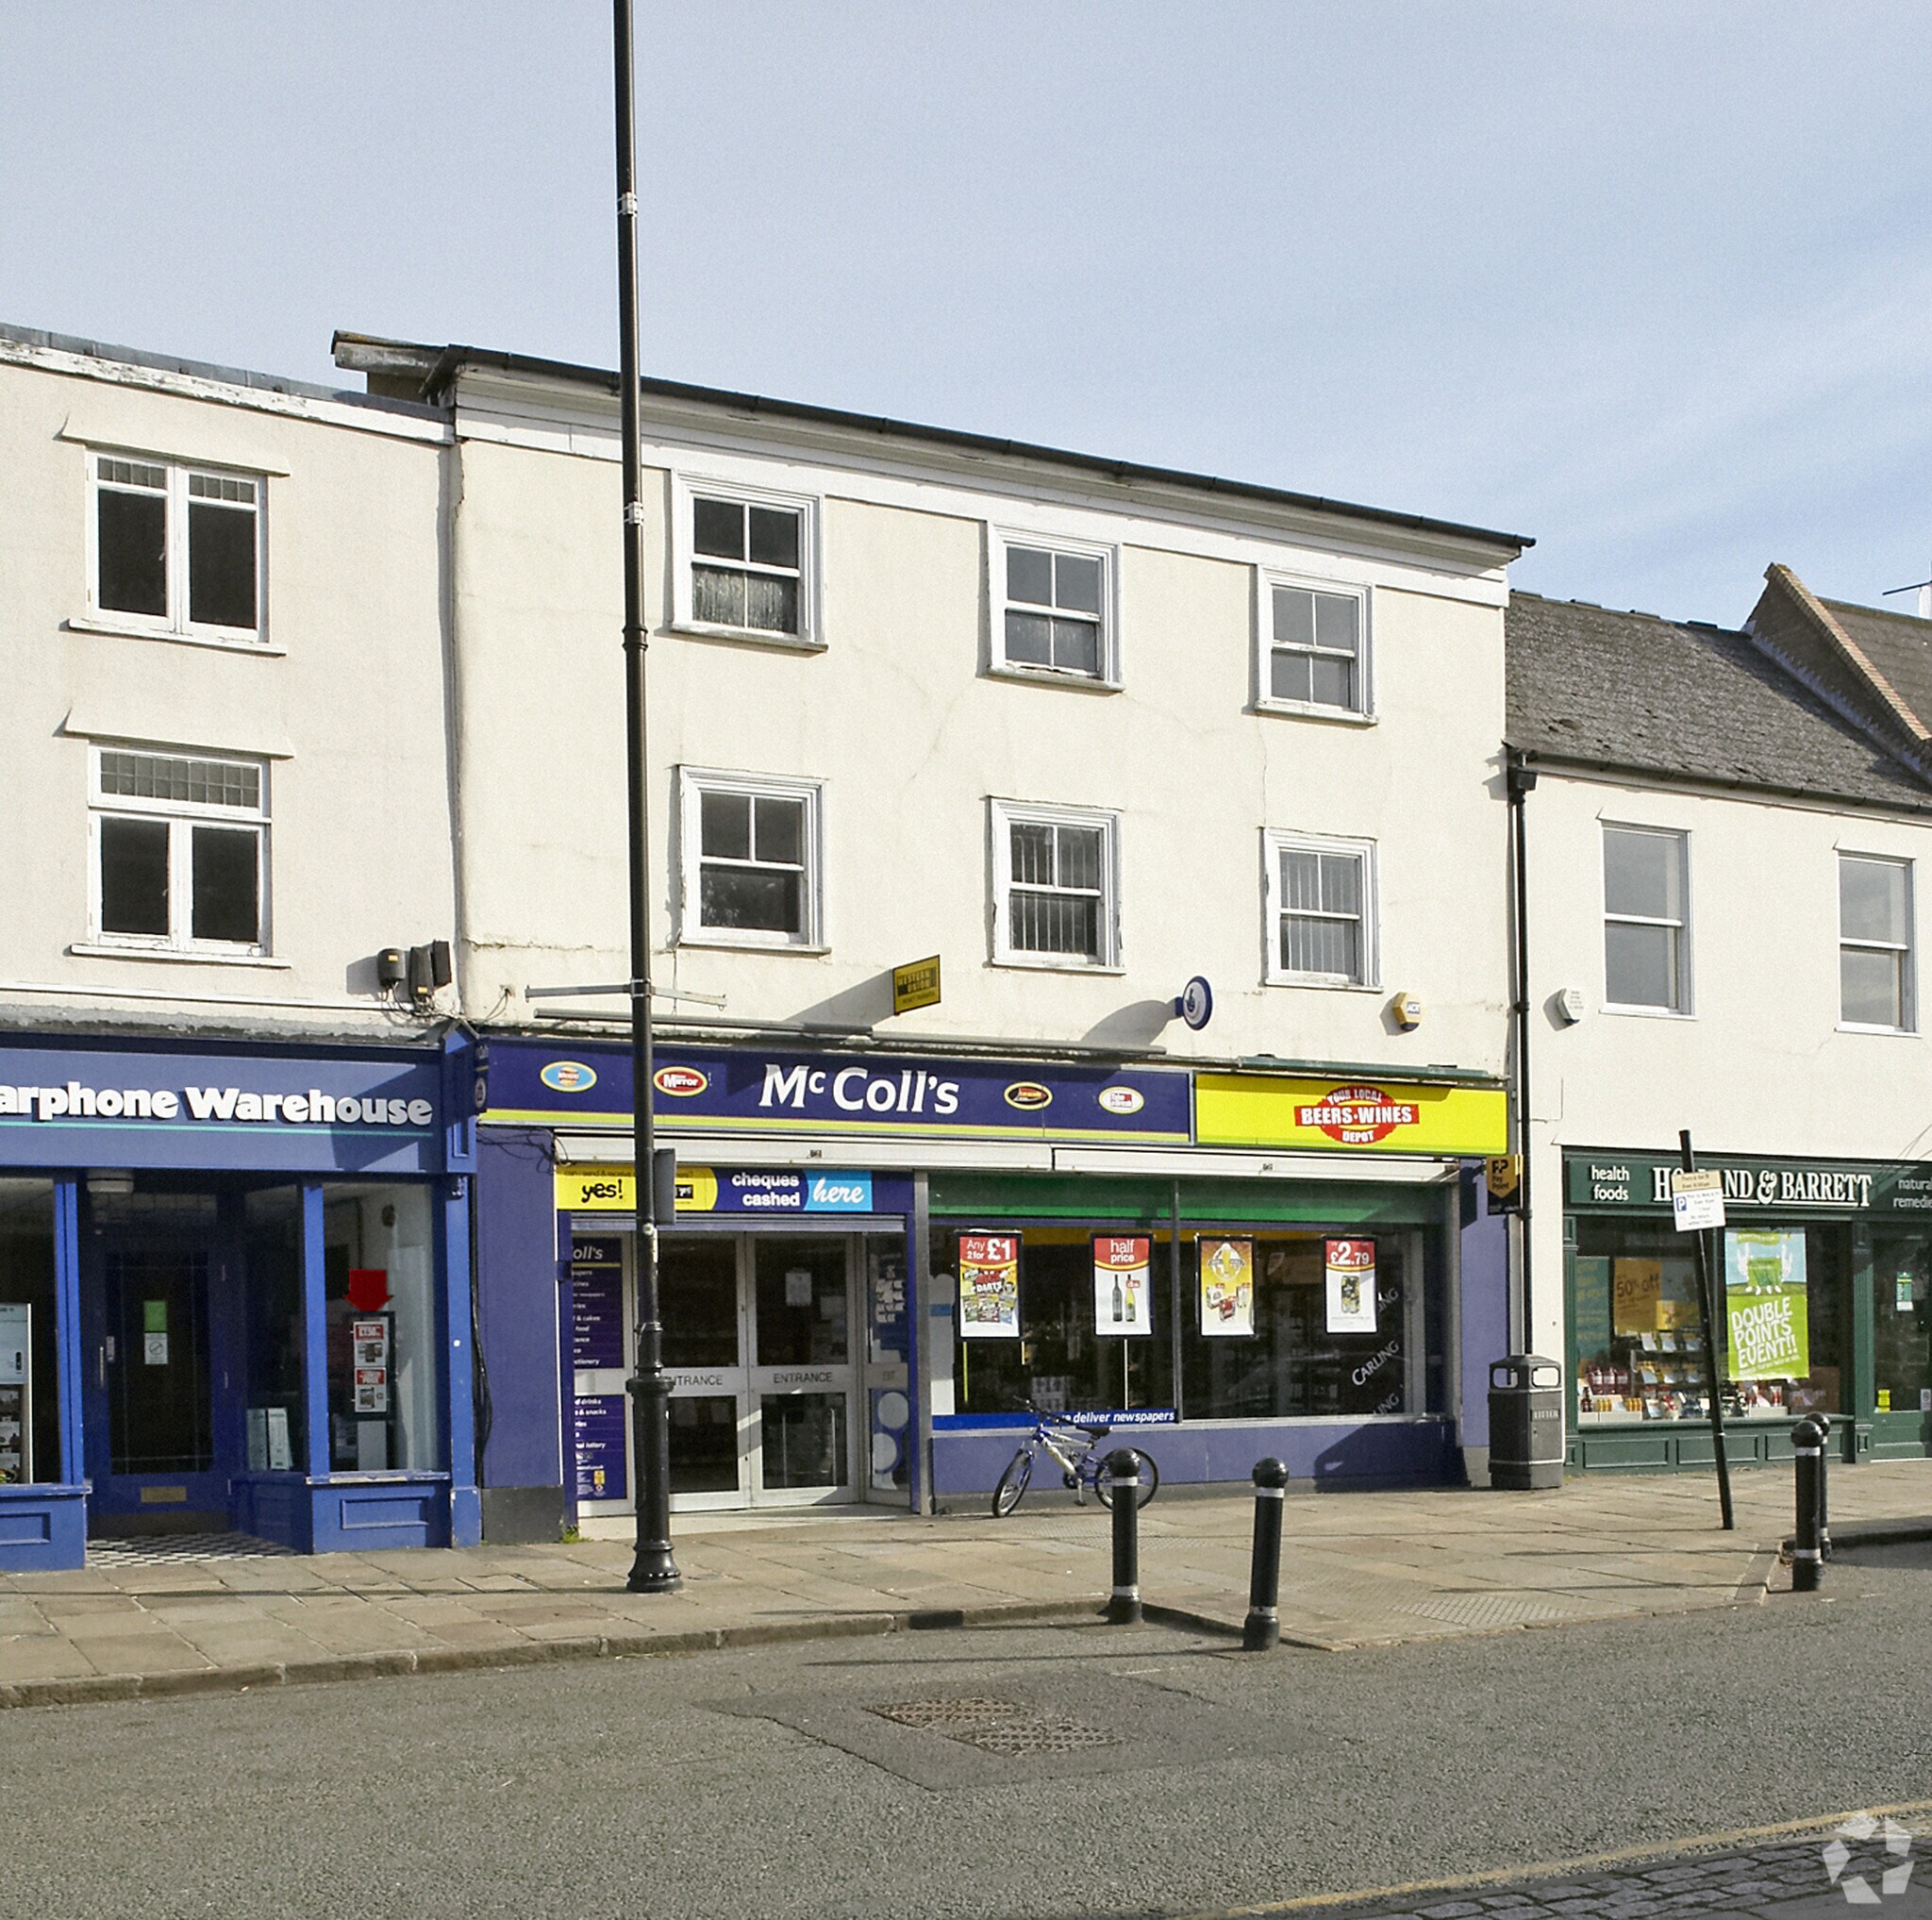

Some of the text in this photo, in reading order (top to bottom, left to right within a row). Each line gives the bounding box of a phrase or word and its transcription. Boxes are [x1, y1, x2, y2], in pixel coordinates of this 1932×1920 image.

[185, 1087, 433, 1126] Warehouse
[1326, 1089, 1382, 1105] YOUR LOCAL
[1341, 1130, 1374, 1143] DEPOT
[731, 1173, 799, 1190] cheques
[1591, 1165, 1630, 1181] health
[581, 1179, 623, 1203] yes!
[742, 1177, 864, 1207] cashed here
[1593, 1184, 1629, 1201] foods
[1757, 1170, 1777, 1205] &
[1780, 1172, 1873, 1207] BARRETT
[573, 1245, 604, 1260] oll's
[967, 1238, 1011, 1261] Any £1
[1110, 1239, 1135, 1253] half
[1330, 1242, 1370, 1265] £2.79
[1110, 1252, 1135, 1264] price
[1731, 1296, 1793, 1330] DOUBLE
[1734, 1317, 1792, 1350] POINTS
[1738, 1333, 1798, 1369] EVENT!!
[1352, 1340, 1399, 1386] CARLING
[664, 1372, 833, 1386] NTRANCE ENTRANCE
[1073, 1411, 1111, 1424] deliver
[1113, 1411, 1174, 1424] newspapers
